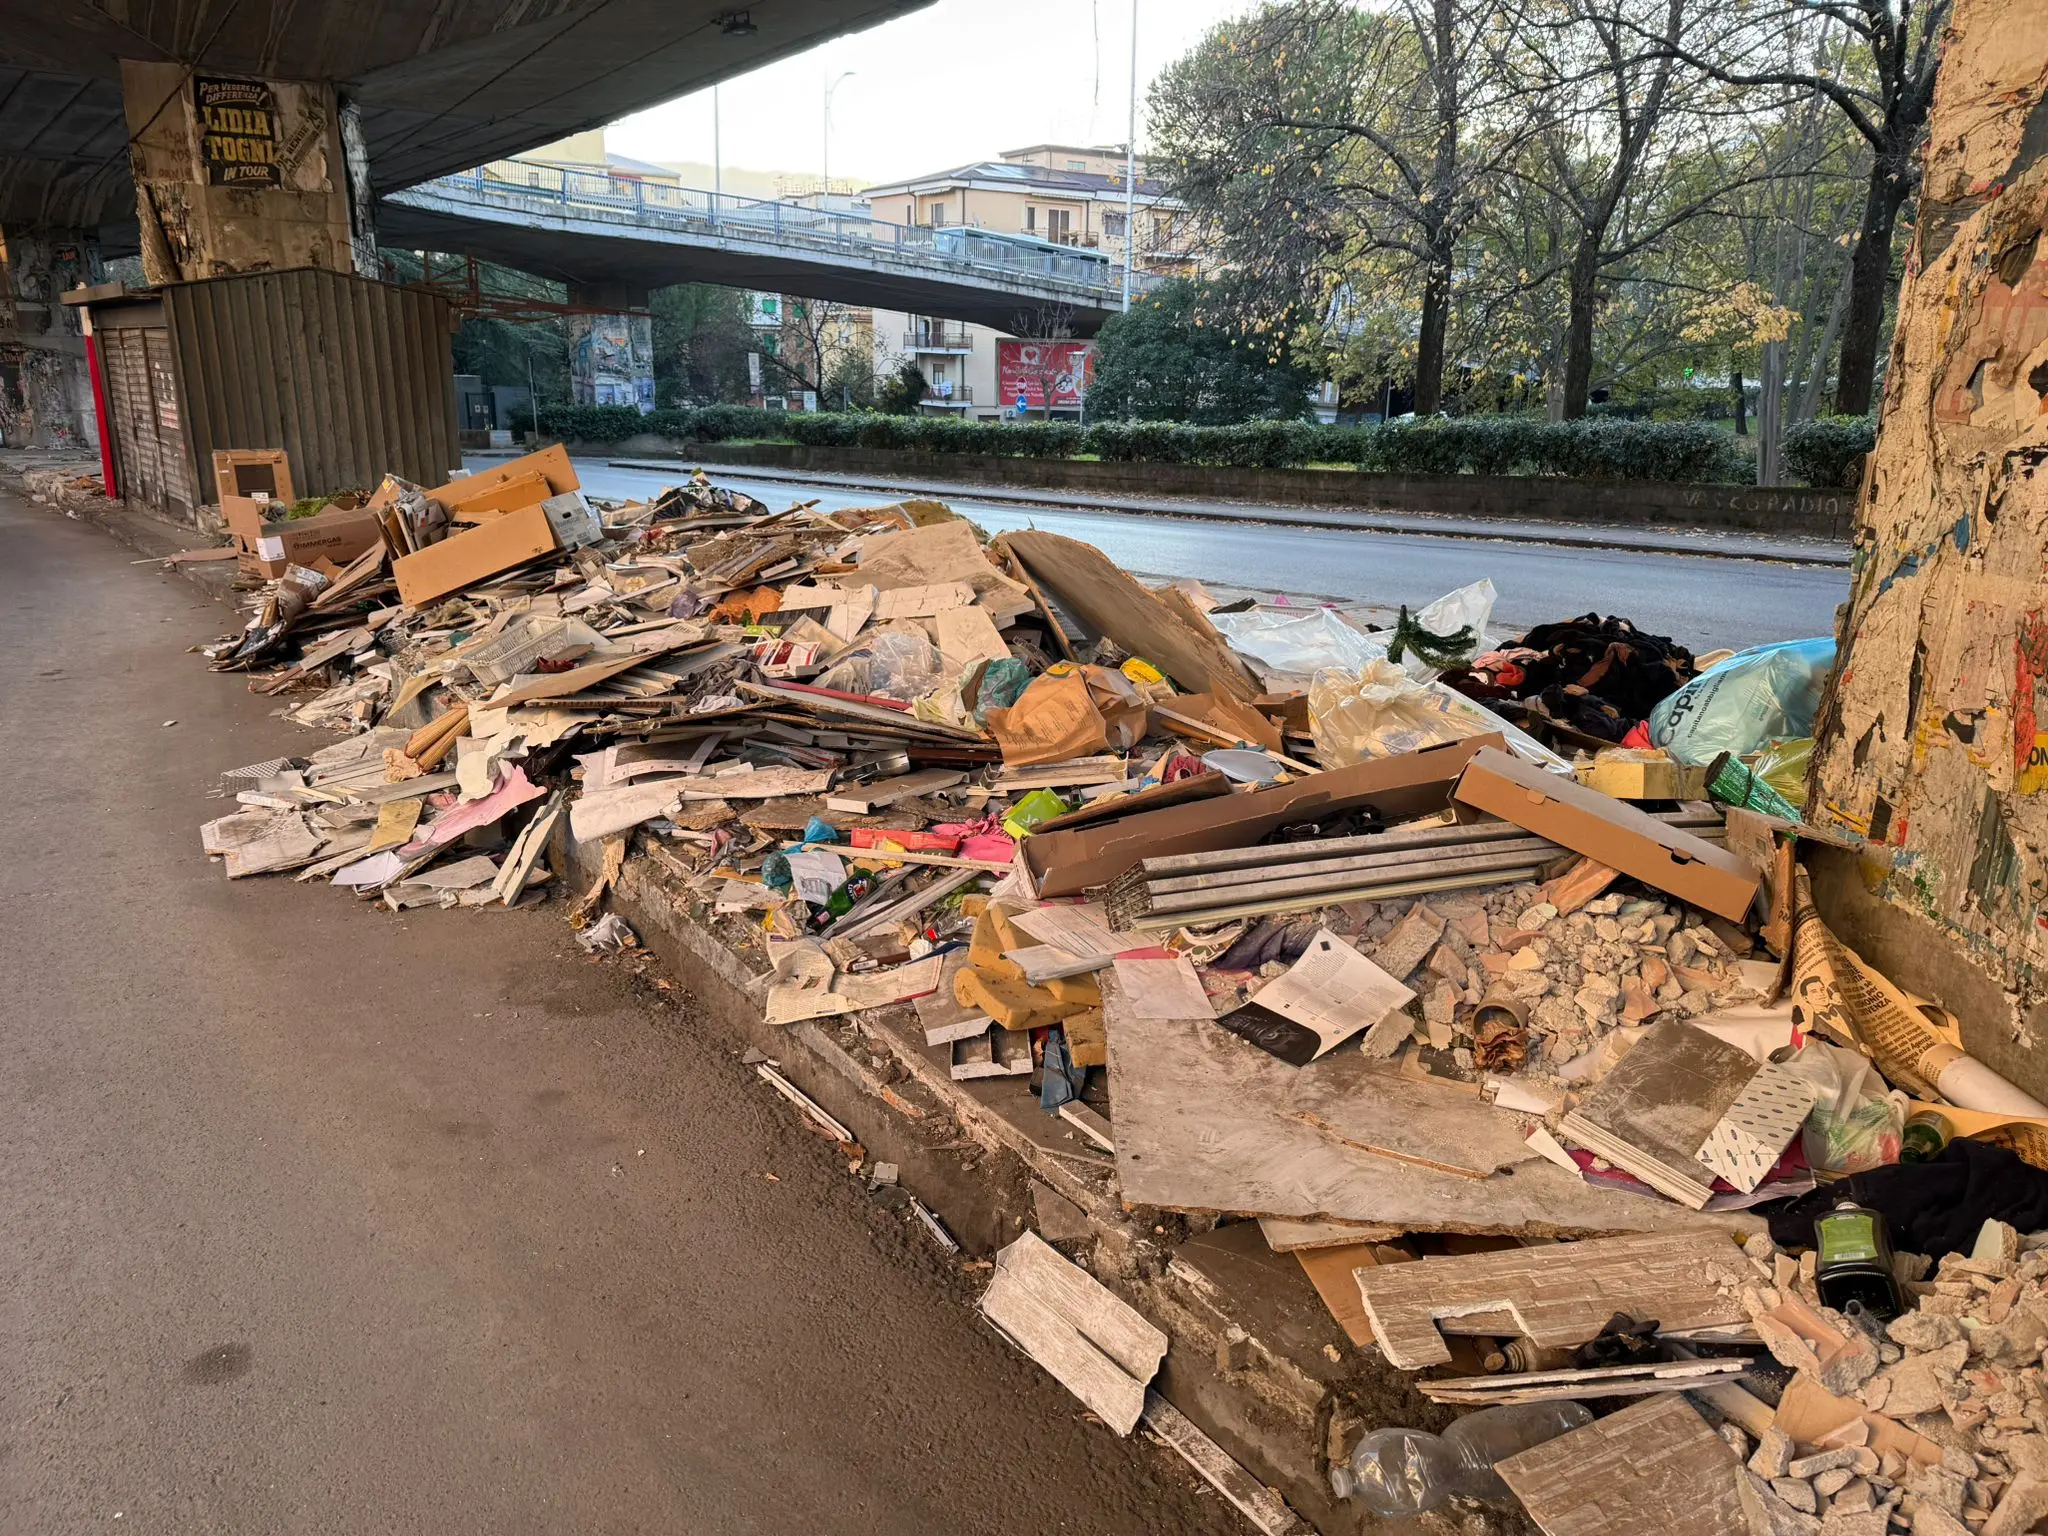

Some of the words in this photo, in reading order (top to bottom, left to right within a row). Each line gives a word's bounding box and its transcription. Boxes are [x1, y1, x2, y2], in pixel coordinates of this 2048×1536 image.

[200, 82, 219, 96] PER
[252, 85, 261, 93] LA
[202, 106, 271, 136] LIDIA
[208, 135, 275, 164] TOGNI
[224, 167, 238, 181] IN
[239, 166, 269, 177] TOUR
[301, 536, 342, 549] IMMERGAS
[1909, 1034, 1932, 1049] Agenzia
